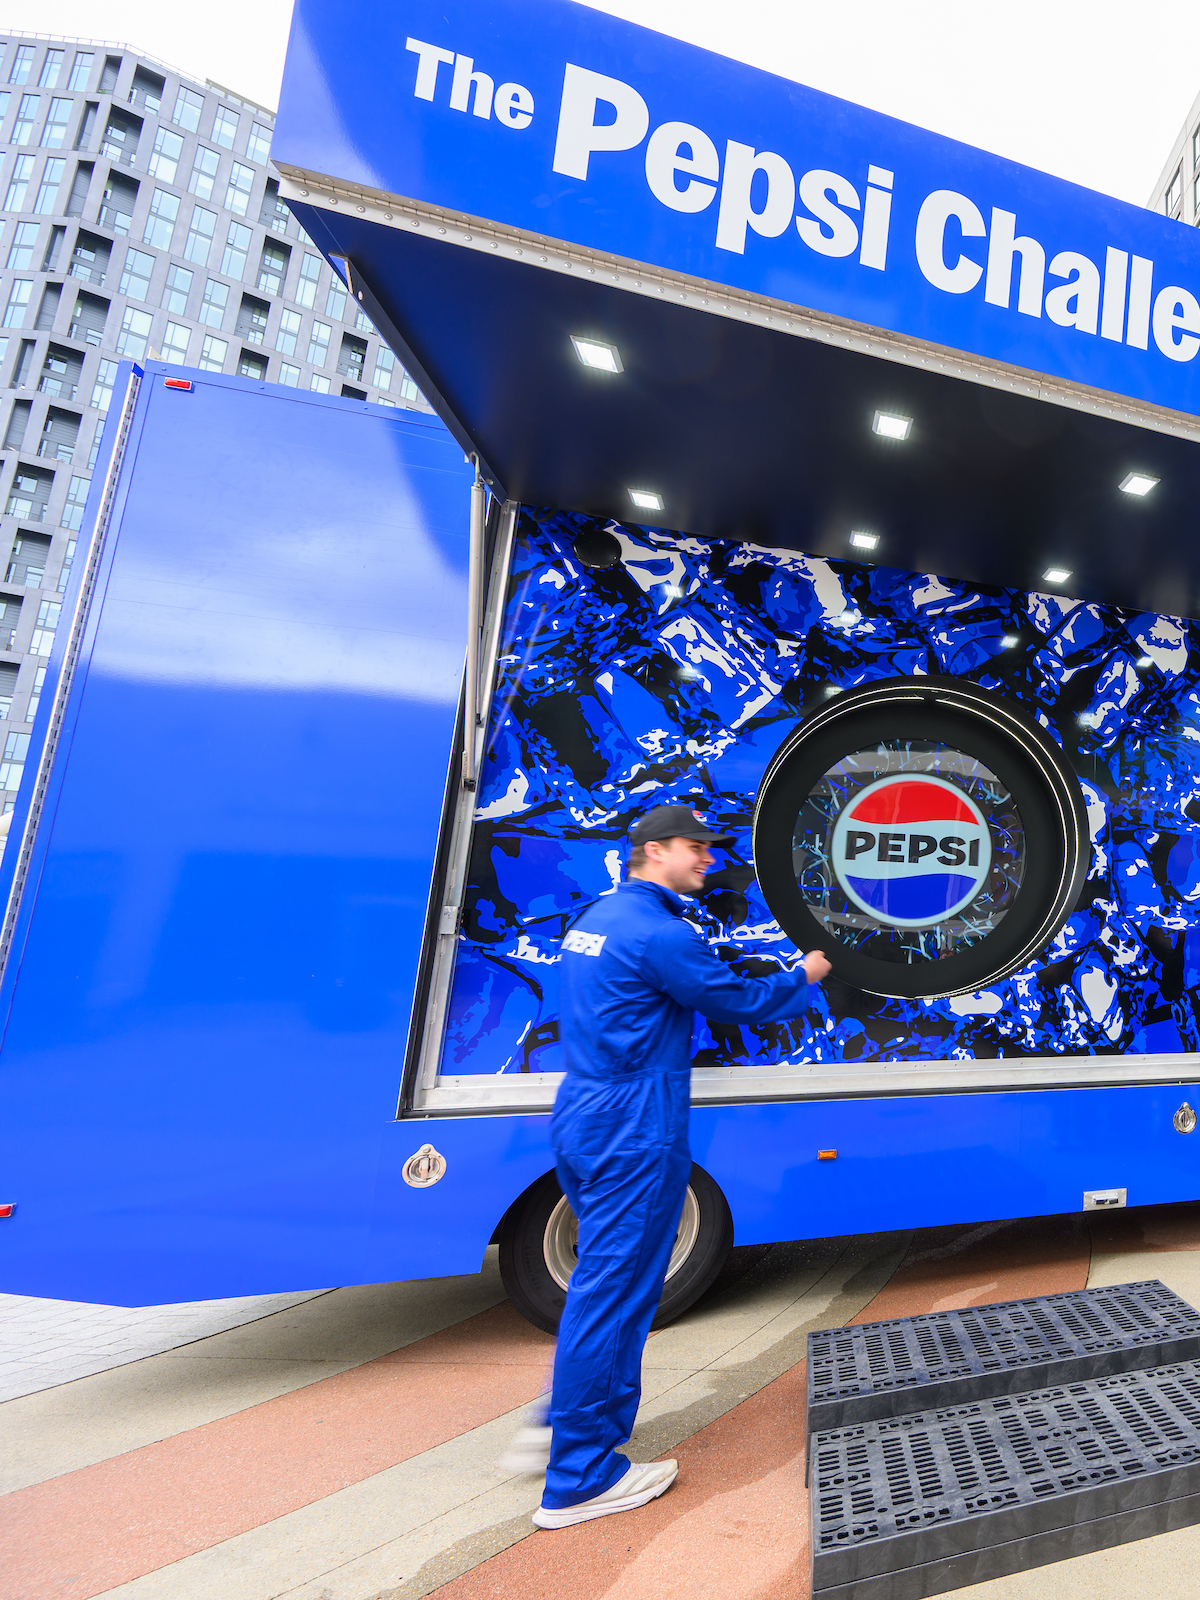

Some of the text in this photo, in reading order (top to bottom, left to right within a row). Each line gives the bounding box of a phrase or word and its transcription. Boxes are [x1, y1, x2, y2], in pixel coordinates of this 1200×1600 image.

[405, 36, 535, 130] The
[552, 62, 895, 272] Pepsi
[844, 830, 980, 867] PEPSI
